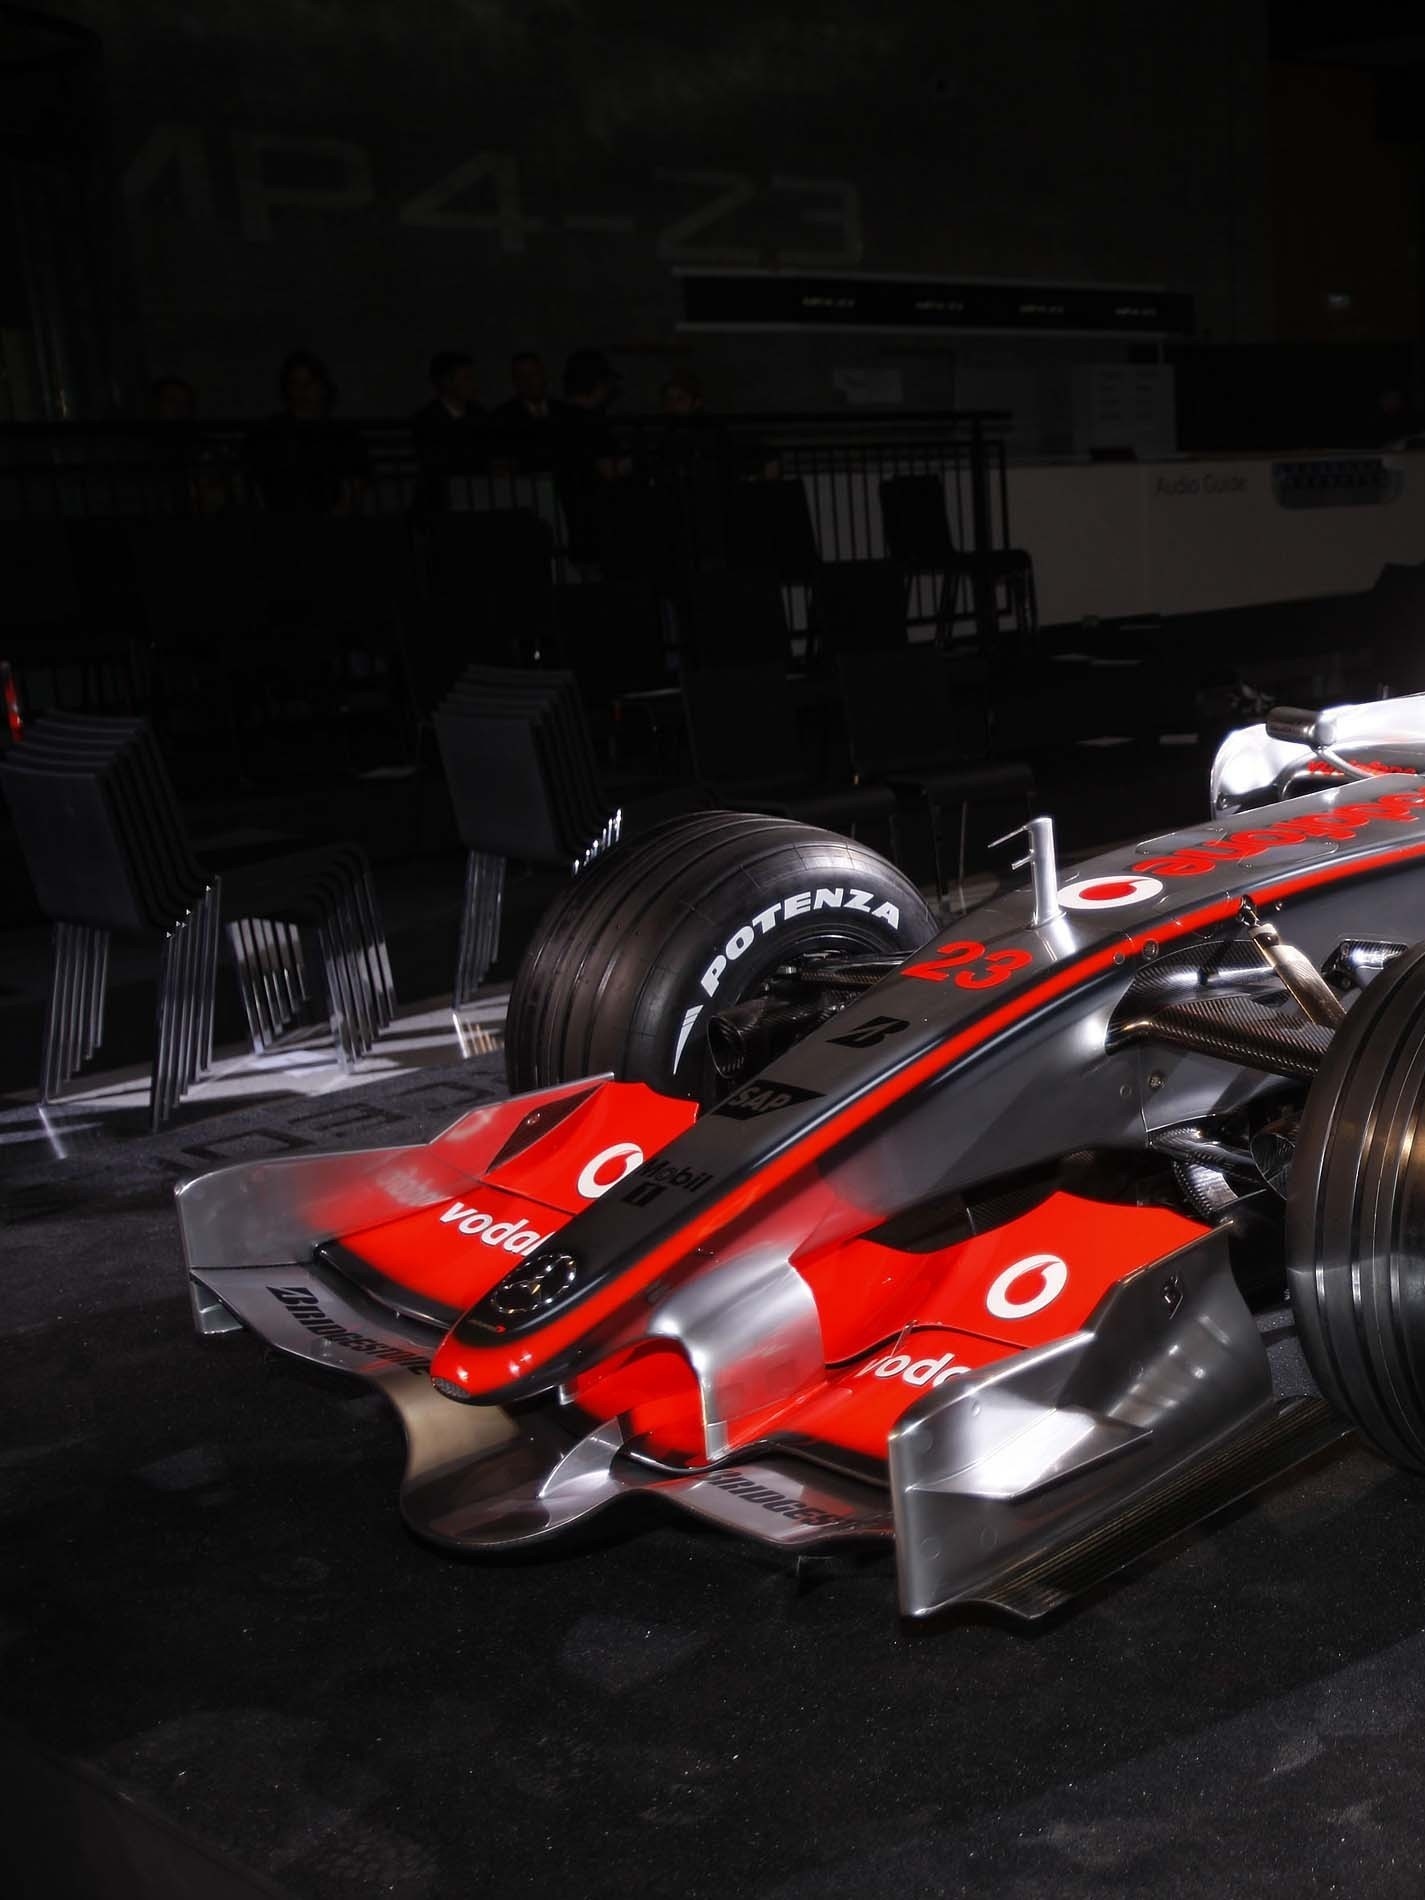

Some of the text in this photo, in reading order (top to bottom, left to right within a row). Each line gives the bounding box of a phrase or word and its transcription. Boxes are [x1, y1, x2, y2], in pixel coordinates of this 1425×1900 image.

[701, 887, 901, 998] POTENZA
[901, 940, 1032, 990] 23
[728, 1086, 794, 1112] SAP
[635, 1159, 713, 1193] Mobil
